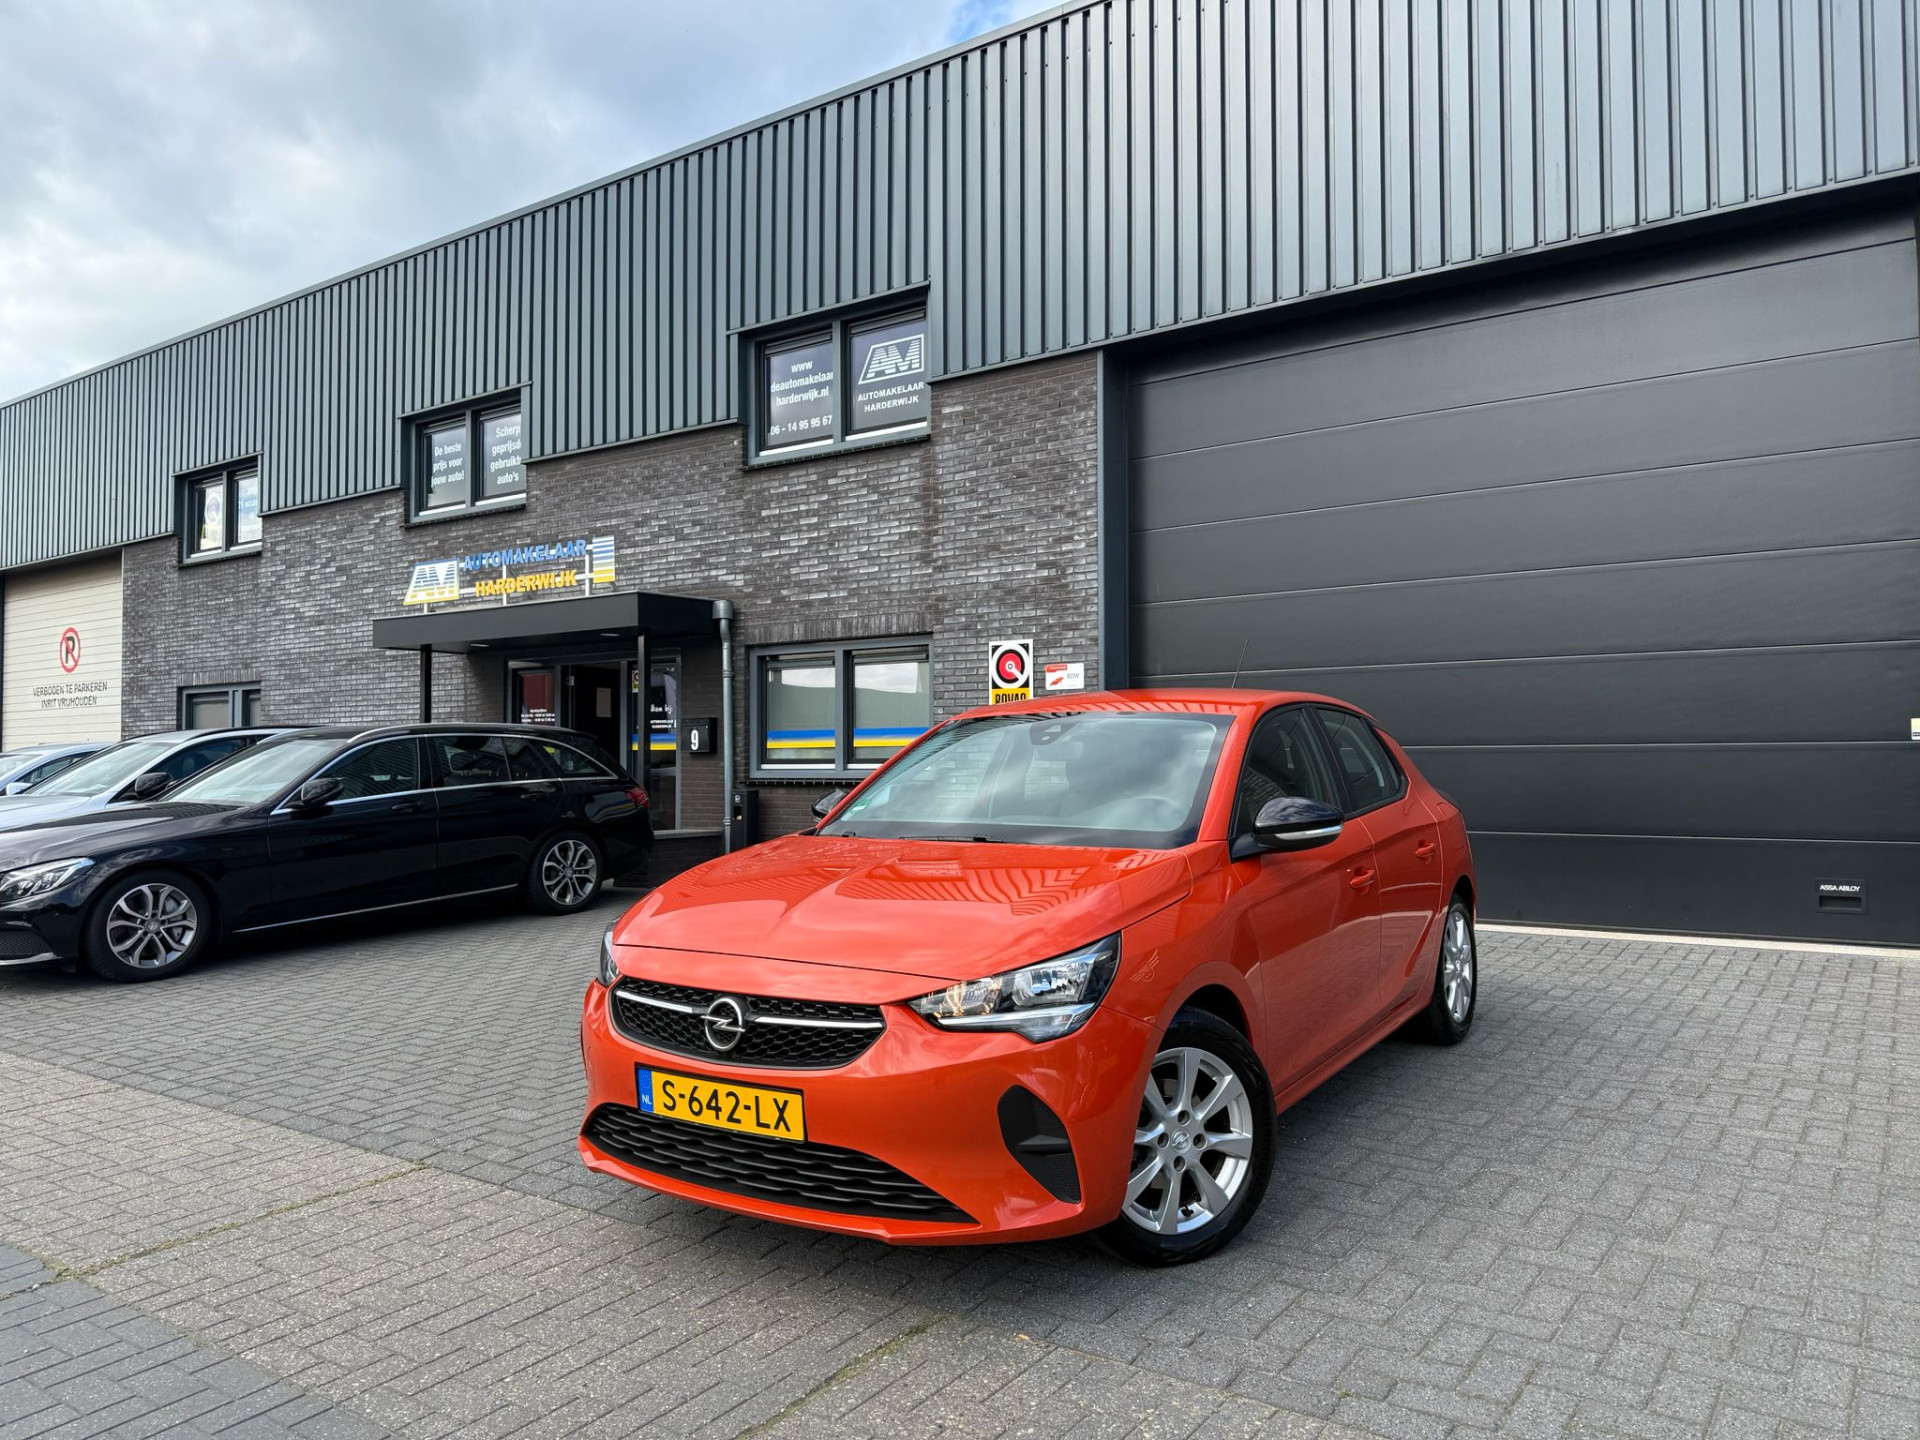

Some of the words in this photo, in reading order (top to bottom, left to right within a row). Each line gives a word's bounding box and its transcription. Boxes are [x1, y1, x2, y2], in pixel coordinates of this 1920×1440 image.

[791, 360, 813, 373] www
[776, 386, 829, 406] harderwijk.nl
[858, 382, 924, 402] AUTOMAKELAAR
[864, 395, 919, 413] HARDERWIJK
[496, 425, 520, 438] Scherp
[770, 425, 780, 435] 06
[788, 421, 797, 432] 14
[799, 419, 808, 430] 95
[811, 417, 821, 428] 95
[823, 415, 833, 426] 67
[435, 446, 443, 456] De
[444, 443, 462, 455] beste
[433, 461, 447, 473] prijs
[449, 458, 463, 468] voor
[431, 475, 447, 488] jouw
[448, 470, 464, 482] auto!
[497, 472, 519, 485] auto's
[463, 539, 587, 571] AUTOMAKELAAR
[476, 569, 578, 597] HARDERWIJK
[33, 685, 64, 697] VERBODEN
[65, 684, 73, 694] TE
[74, 681, 108, 693] PARKEREN
[41, 698, 57, 708] INRIT
[691, 729, 699, 750] 9
[641, 1094, 652, 1104] NL
[662, 1080, 791, 1132] S-642-LX
